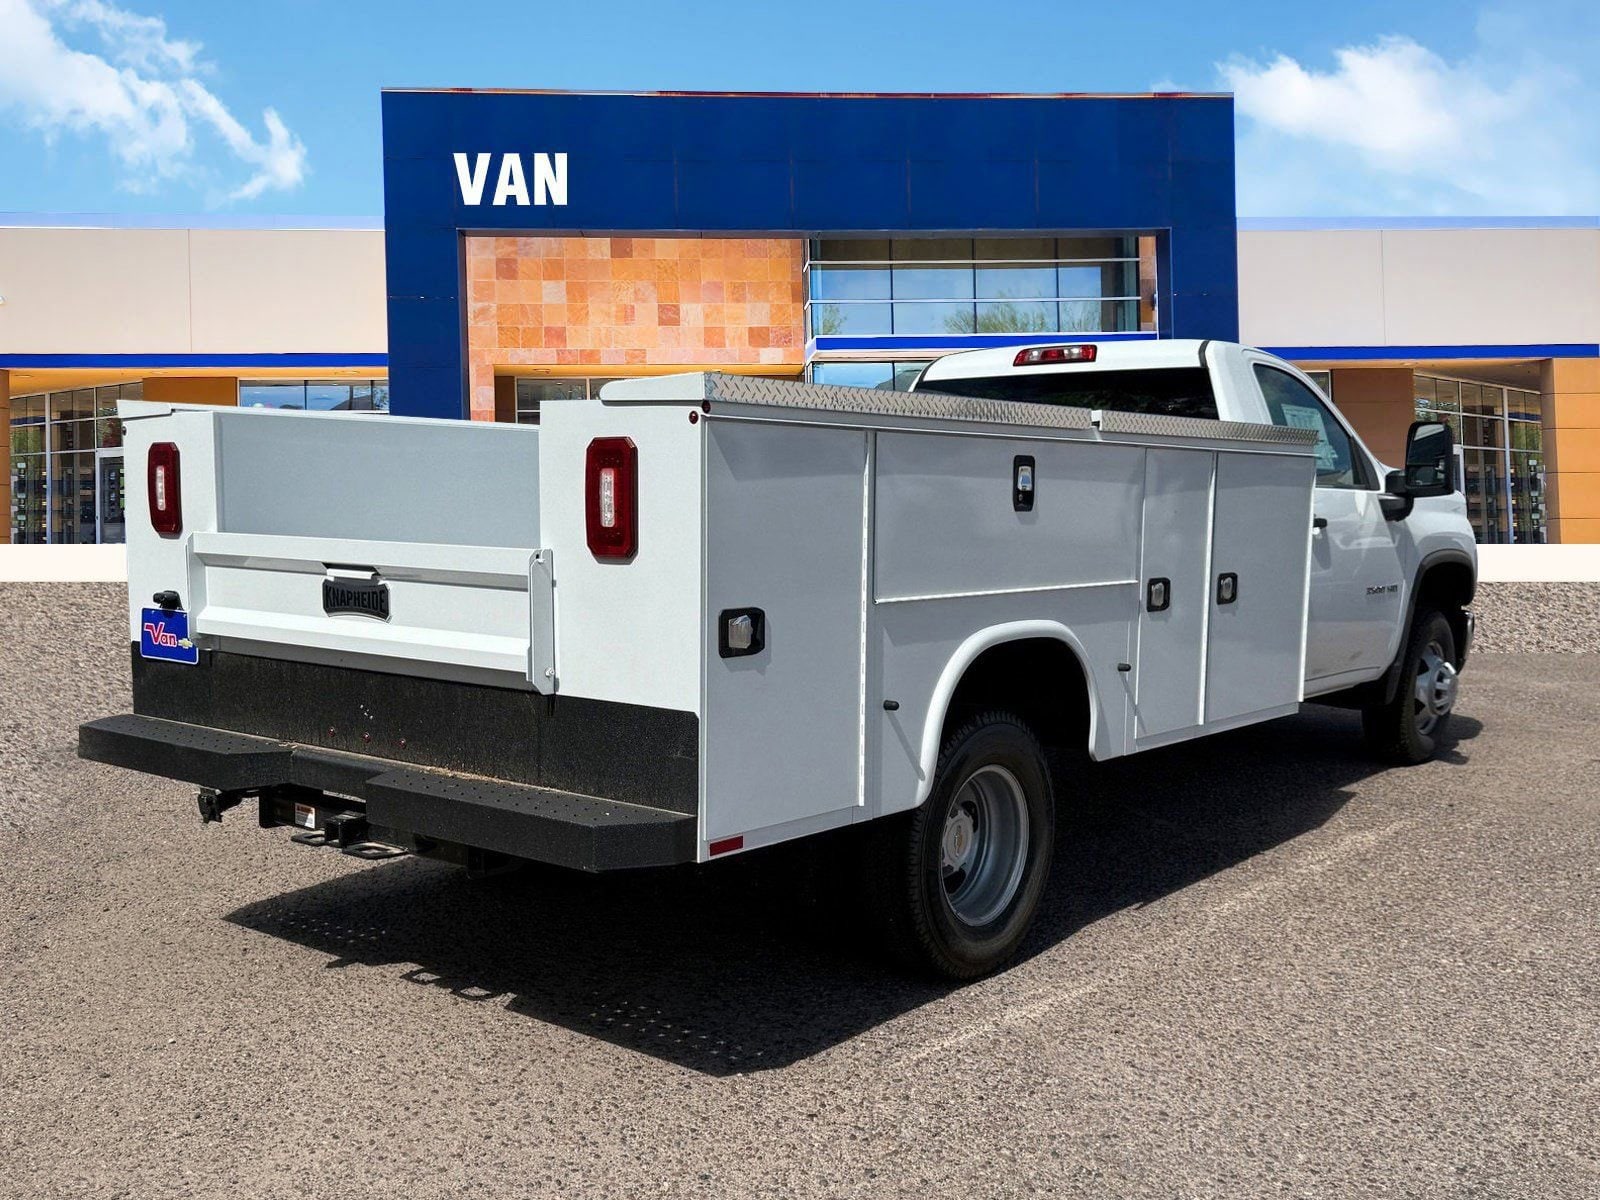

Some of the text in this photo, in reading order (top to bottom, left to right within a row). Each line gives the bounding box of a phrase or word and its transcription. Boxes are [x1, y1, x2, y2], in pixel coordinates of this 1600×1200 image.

[453, 152, 568, 206] VAN
[325, 584, 386, 612] KNAPHEIDE
[143, 622, 178, 648] Van
